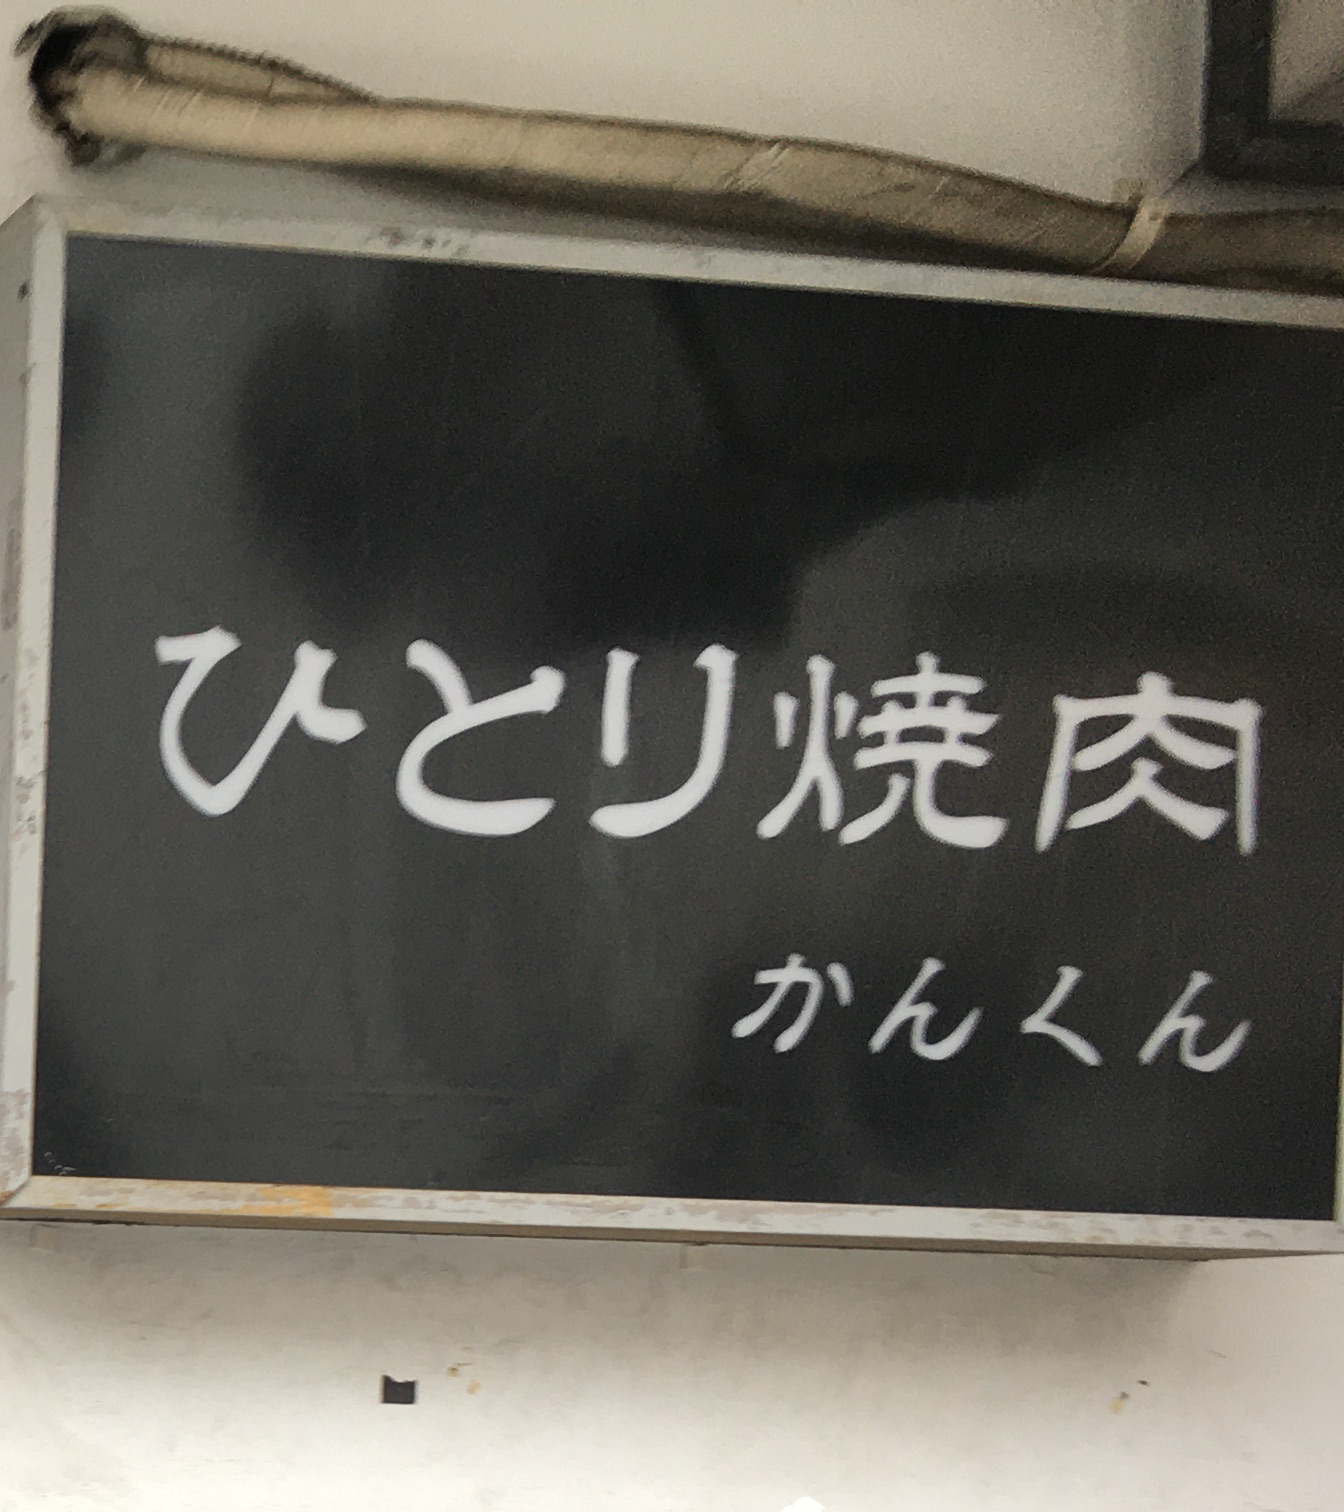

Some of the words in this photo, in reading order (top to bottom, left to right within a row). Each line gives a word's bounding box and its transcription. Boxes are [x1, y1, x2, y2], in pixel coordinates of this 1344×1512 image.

[156, 626, 1262, 855] ひとり焼肉
[732, 952, 1252, 1074] かんくん
